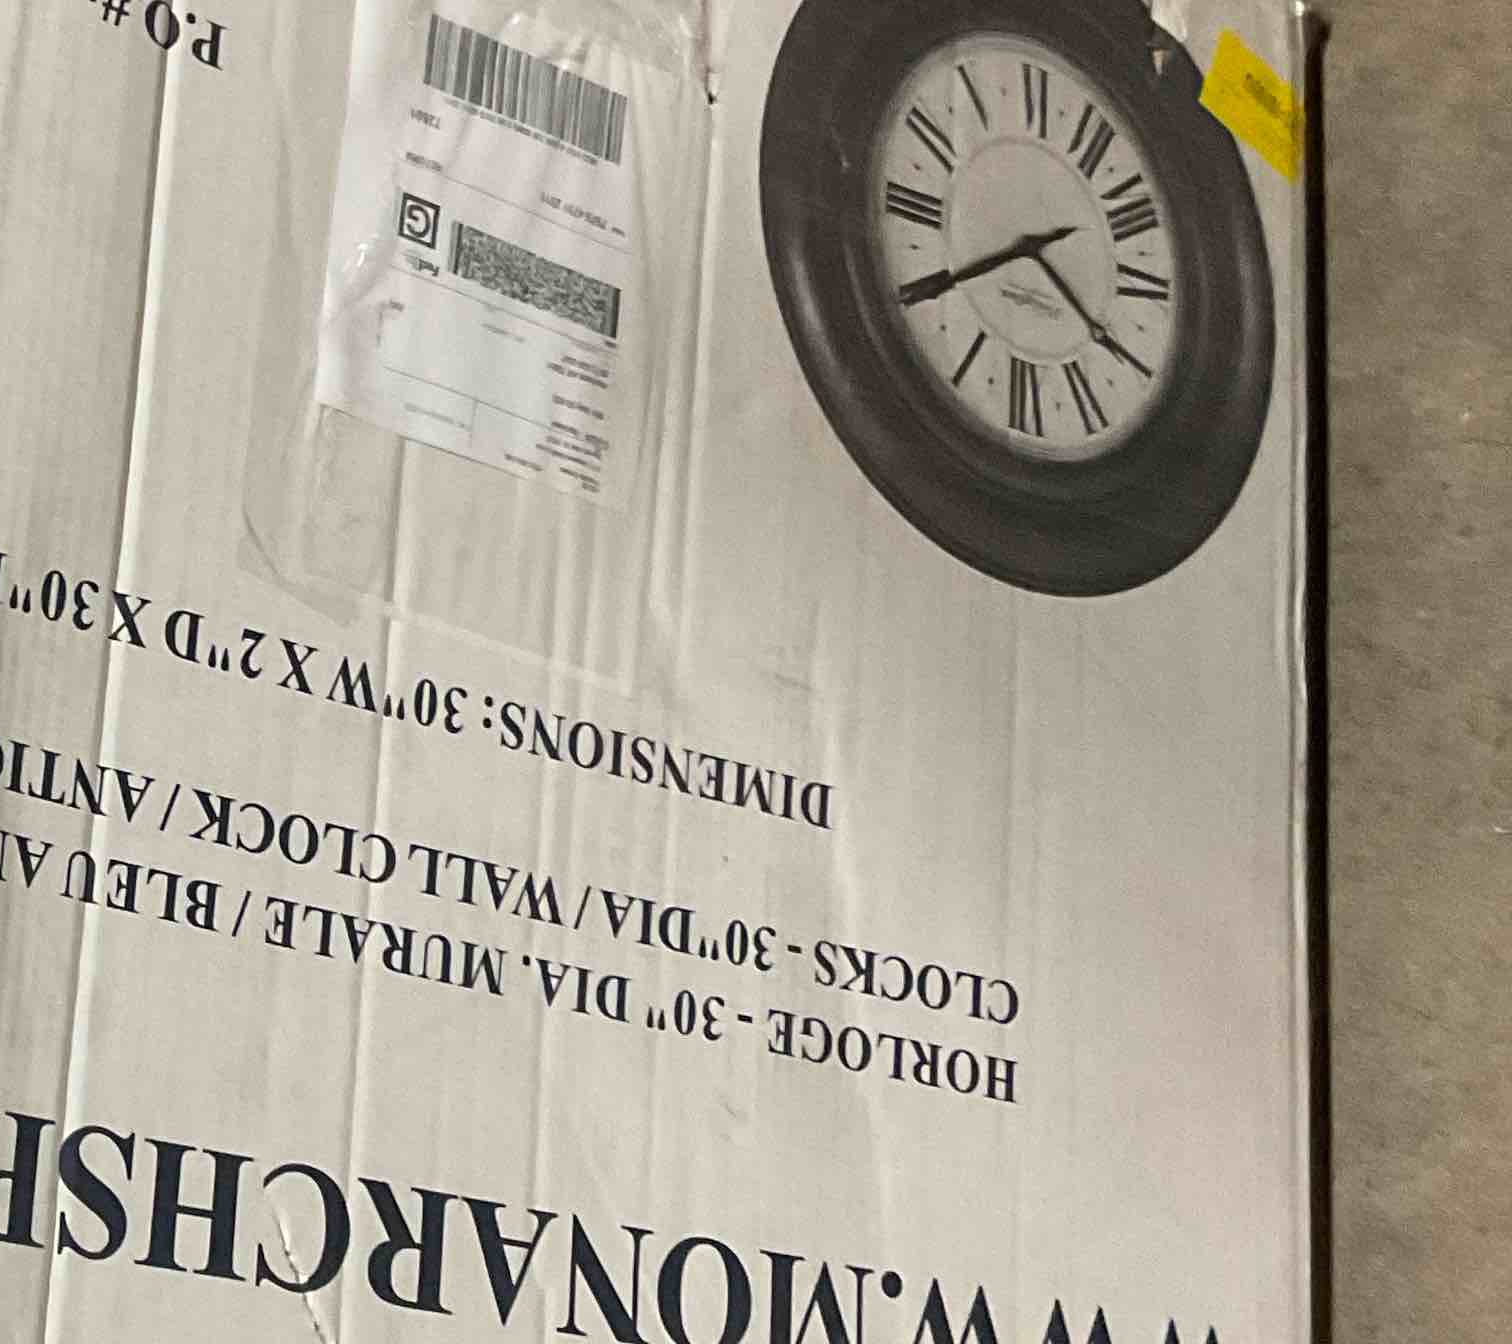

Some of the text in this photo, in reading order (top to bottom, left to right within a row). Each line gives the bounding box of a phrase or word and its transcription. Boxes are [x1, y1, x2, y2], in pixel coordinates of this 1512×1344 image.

[104, 590, 153, 649] X
[276, 638, 318, 695] X
[482, 694, 833, 831] DIMENSIONS:
[188, 789, 398, 885] CLOCK
[59, 851, 221, 932] BLEU
[407, 843, 566, 926] WALL
[264, 896, 507, 996] MURALE
[813, 941, 1020, 1026] CLOCKS
[521, 955, 631, 1024] DIA.
[767, 1008, 1018, 1104] HORLOGE
